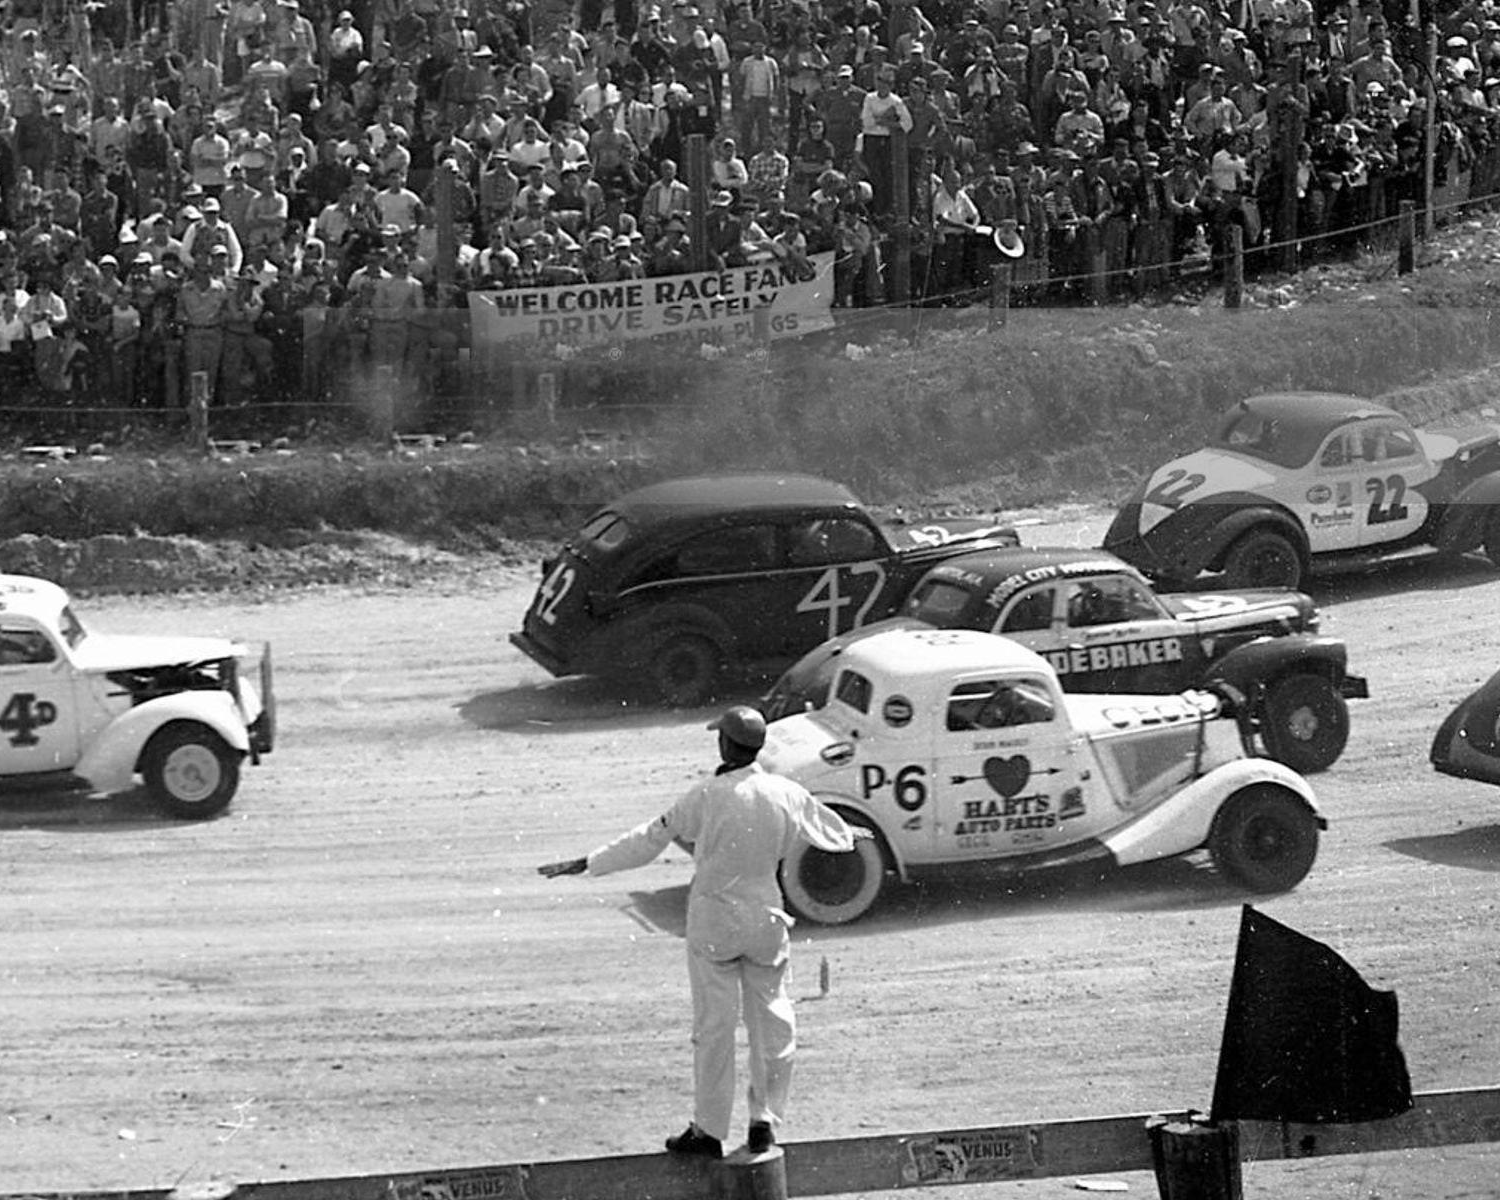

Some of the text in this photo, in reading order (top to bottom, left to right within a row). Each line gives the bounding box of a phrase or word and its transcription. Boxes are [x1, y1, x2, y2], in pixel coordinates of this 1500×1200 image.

[494, 264, 817, 317] WELCOME RACE FANS
[537, 309, 644, 341] DRIVE
[661, 290, 779, 327] SAFELY
[1145, 468, 1207, 511] 22
[1365, 473, 1409, 526] 22
[536, 562, 576, 626] 42
[1025, 565, 1059, 582] CITY
[1044, 637, 1183, 675] DEBAKER
[953, 812, 1057, 836] AUTO PARTS
[962, 1142, 1013, 1159] VENUS
